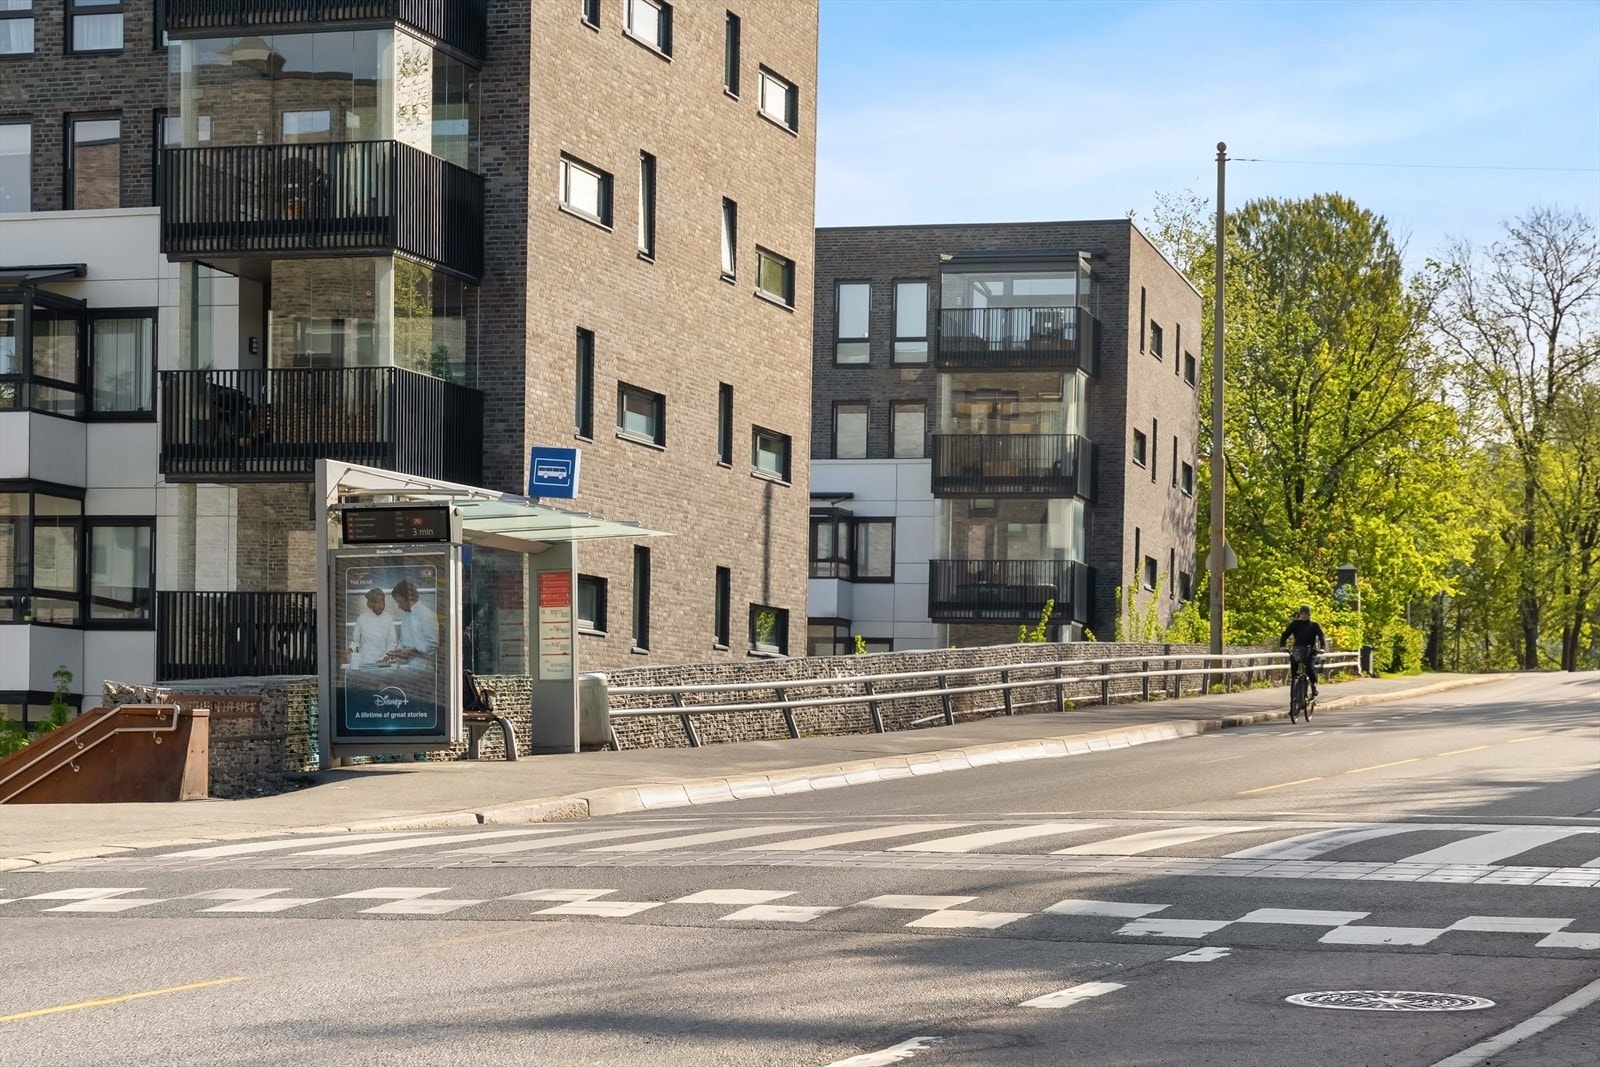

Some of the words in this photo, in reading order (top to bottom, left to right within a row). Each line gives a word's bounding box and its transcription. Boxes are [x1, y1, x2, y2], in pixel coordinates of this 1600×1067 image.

[412, 528, 418, 536] 3
[419, 527, 434, 536] min
[372, 693, 409, 709] Disney+
[390, 711, 407, 720] great
